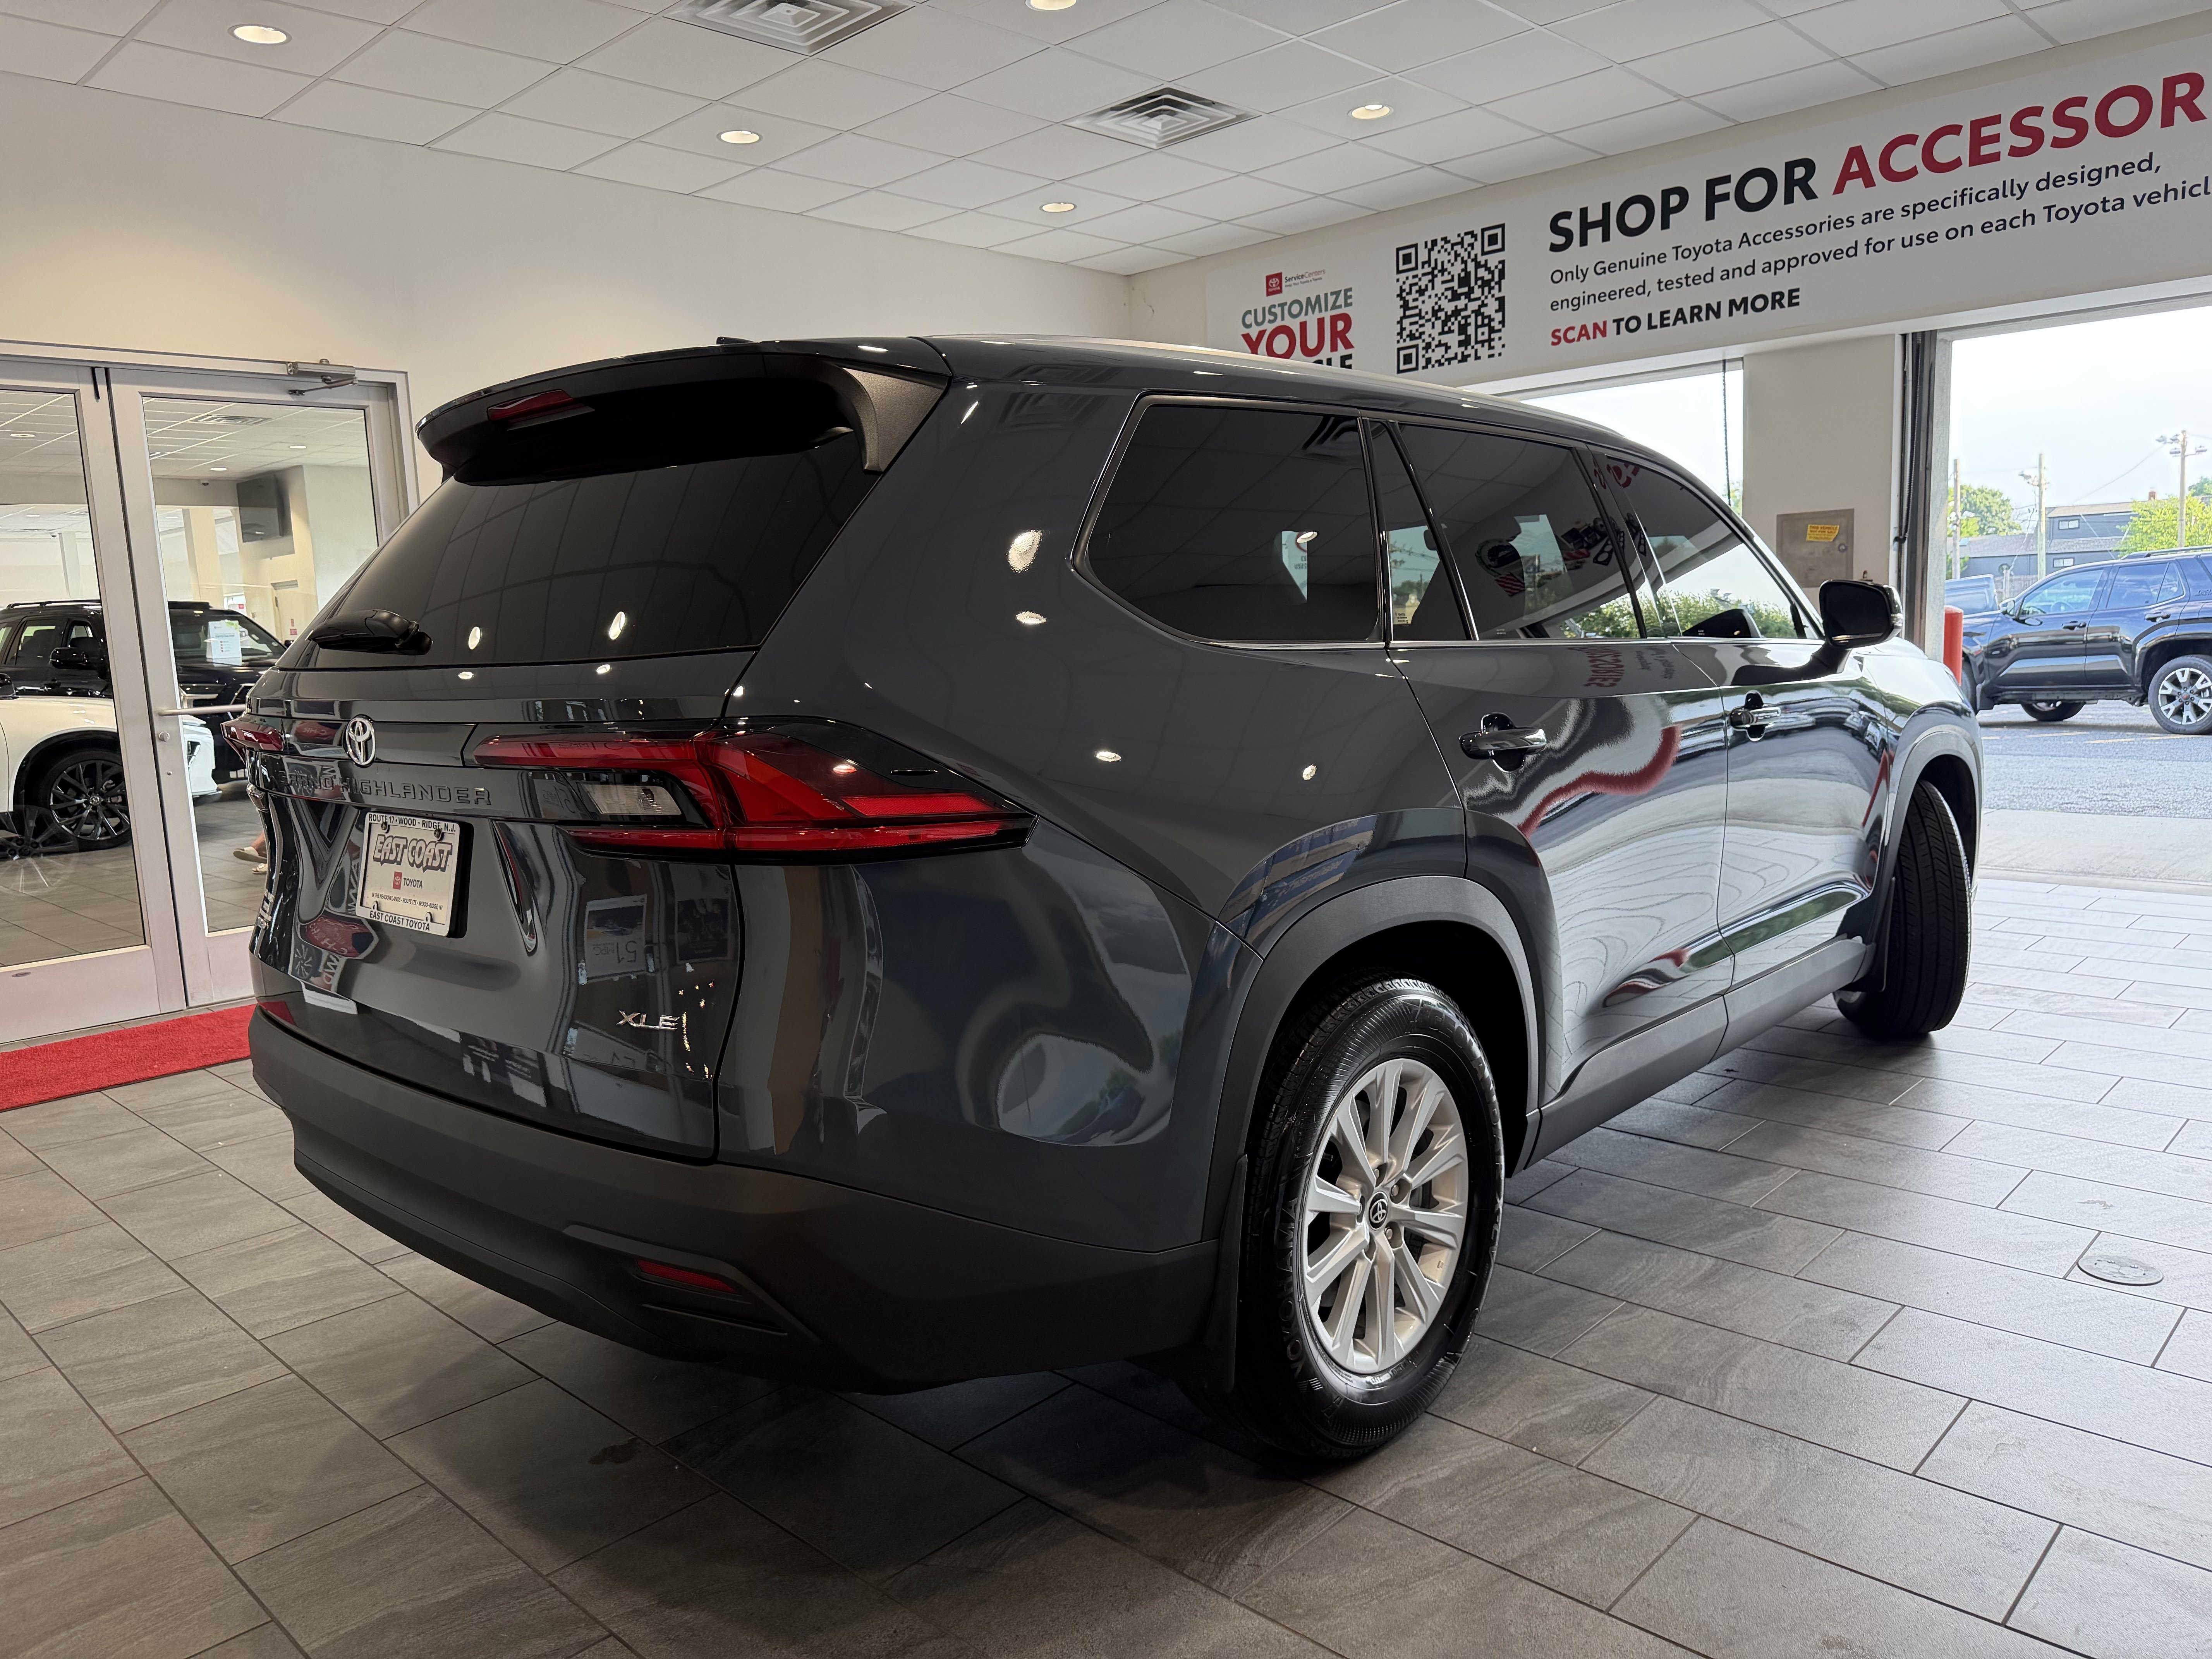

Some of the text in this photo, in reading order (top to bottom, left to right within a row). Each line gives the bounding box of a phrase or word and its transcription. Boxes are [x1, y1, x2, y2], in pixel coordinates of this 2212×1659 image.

[1549, 72, 2207, 252] SHOP FOR ACCESSOR
[1551, 152, 2160, 284] Only Genuine Toyota Accessories are specifically designed,
[1551, 279, 1651, 311] engineered,
[1657, 267, 1714, 292] tested
[1720, 259, 1755, 280] and
[1762, 240, 1858, 276] approved
[1865, 237, 1895, 254] for
[1901, 231, 1938, 248] use
[1946, 225, 1973, 240] on
[1981, 209, 2035, 234] each
[2043, 197, 2124, 223] Toyota
[1242, 287, 1352, 328] CUSTOMIZE
[1551, 288, 1800, 346] SCAN TO LEARN MORE
[1241, 313, 1355, 359] YOUR
[340, 777, 492, 806] HIGHLANDER
[369, 814, 388, 822] ROUTE
[398, 817, 417, 826] WOOD
[444, 823, 456, 832] N.J.
[373, 834, 453, 872] EAST COAST
[404, 878, 422, 889] TOYOTA
[370, 910, 430, 931] EAST COAST TOYOTA
[616, 1010, 680, 1030] XLE
